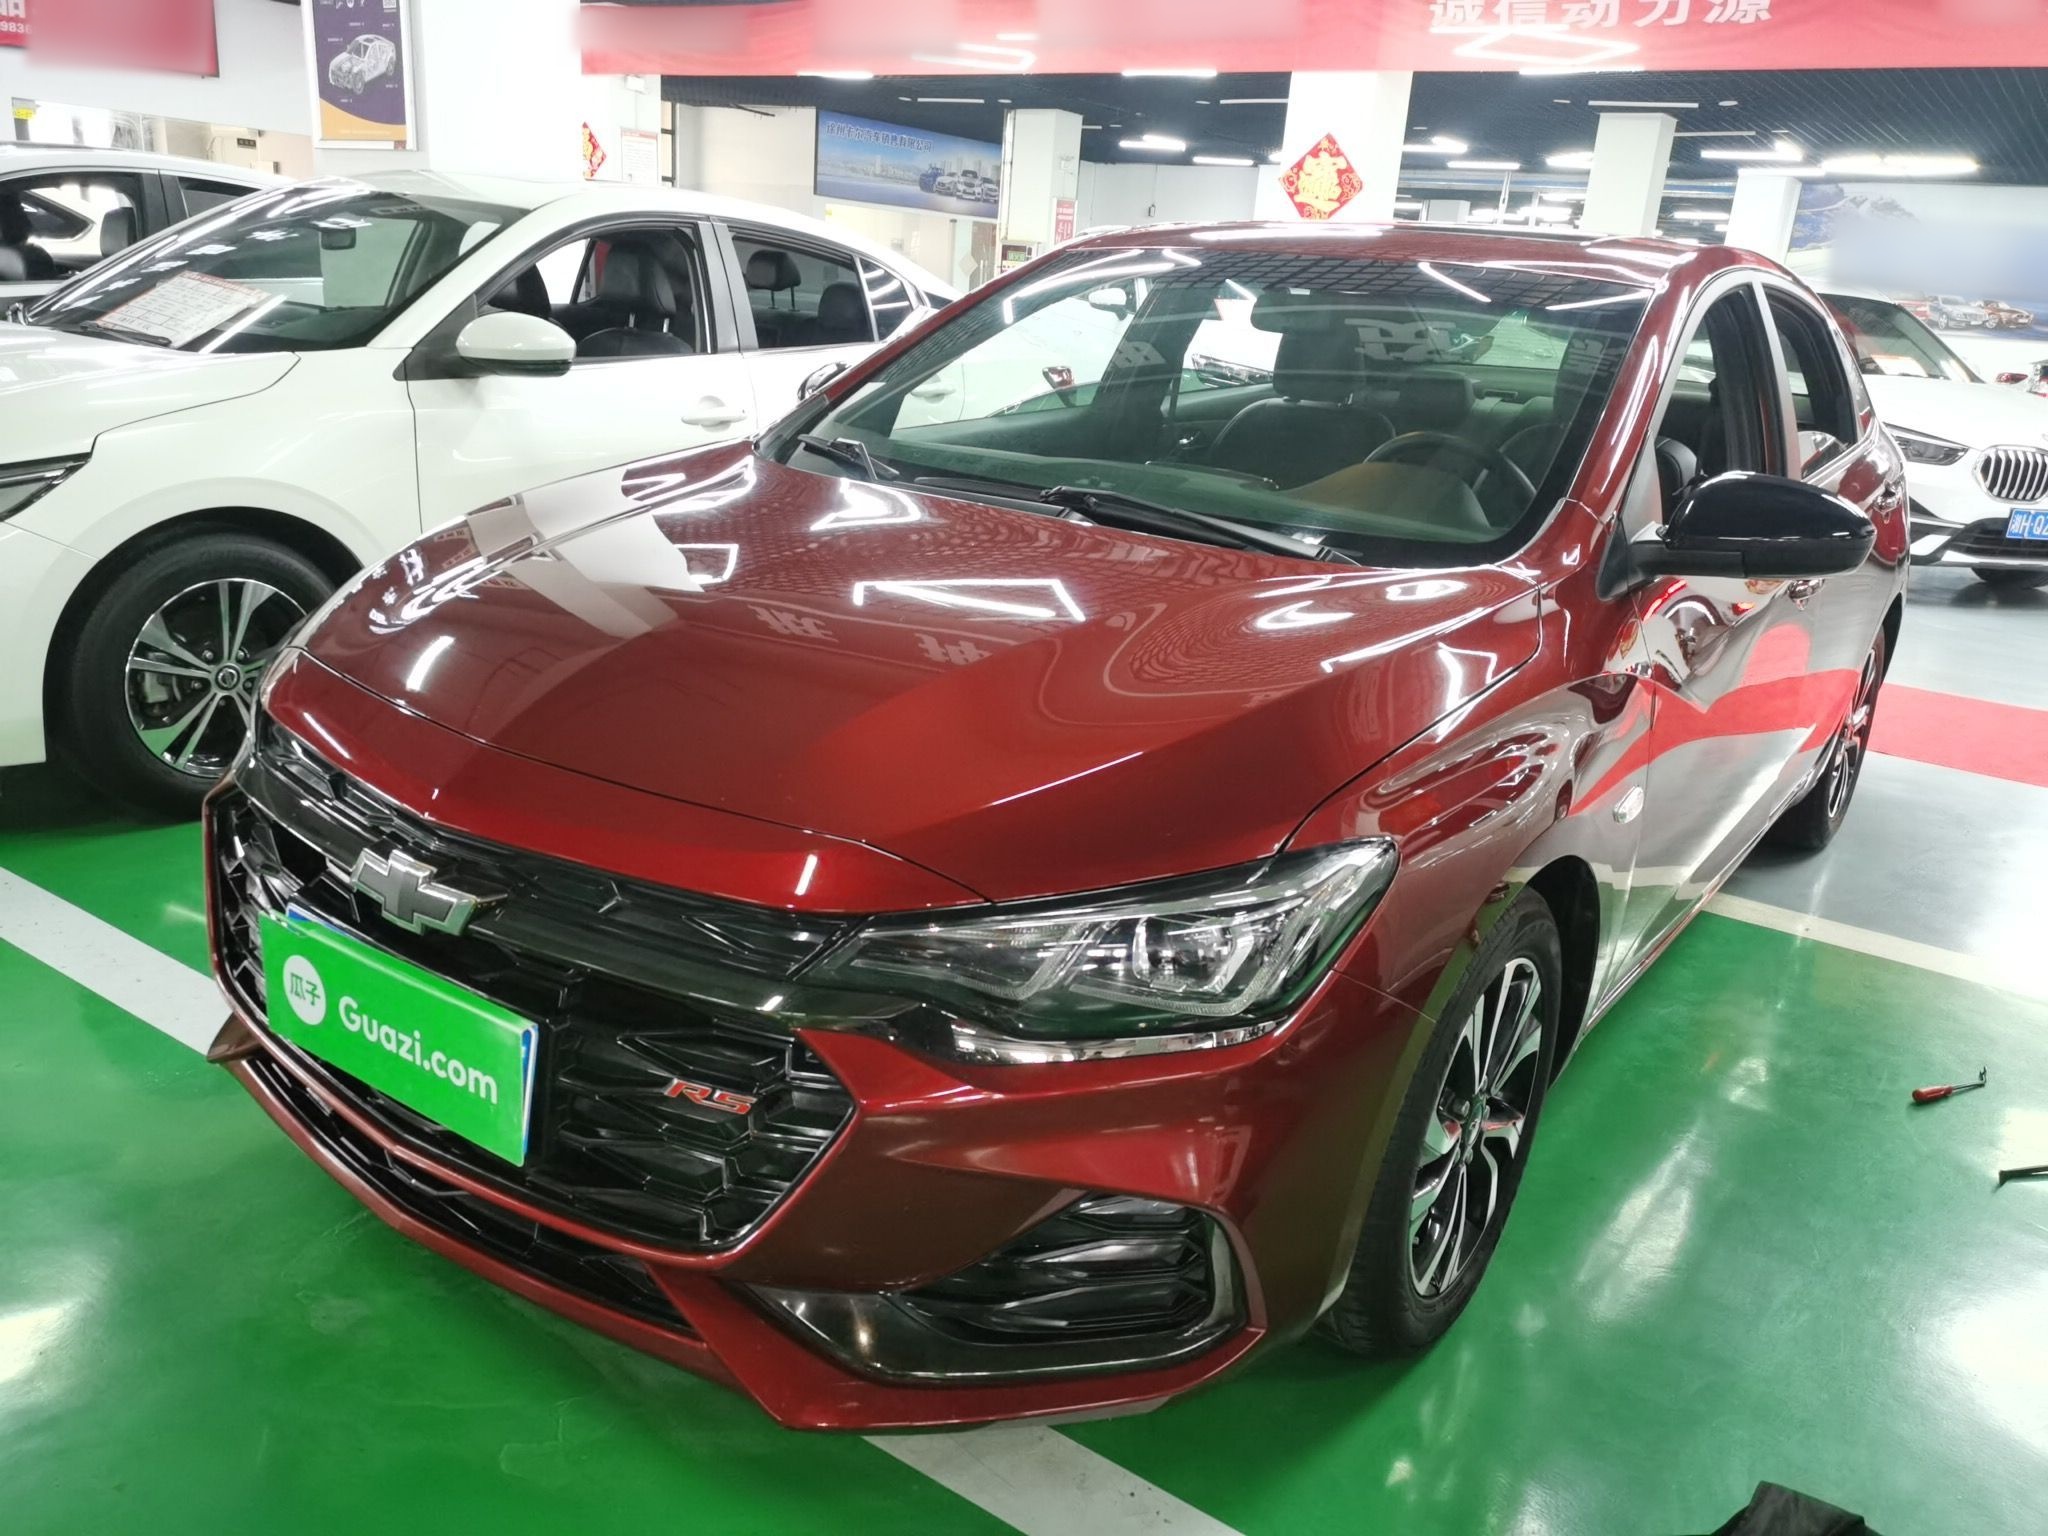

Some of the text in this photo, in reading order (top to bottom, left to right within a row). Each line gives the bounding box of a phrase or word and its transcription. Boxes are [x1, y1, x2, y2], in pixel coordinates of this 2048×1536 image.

[290, 972, 321, 1007] 瓜子
[338, 996, 498, 1105] Guazi.com
[664, 1077, 758, 1115] RS
